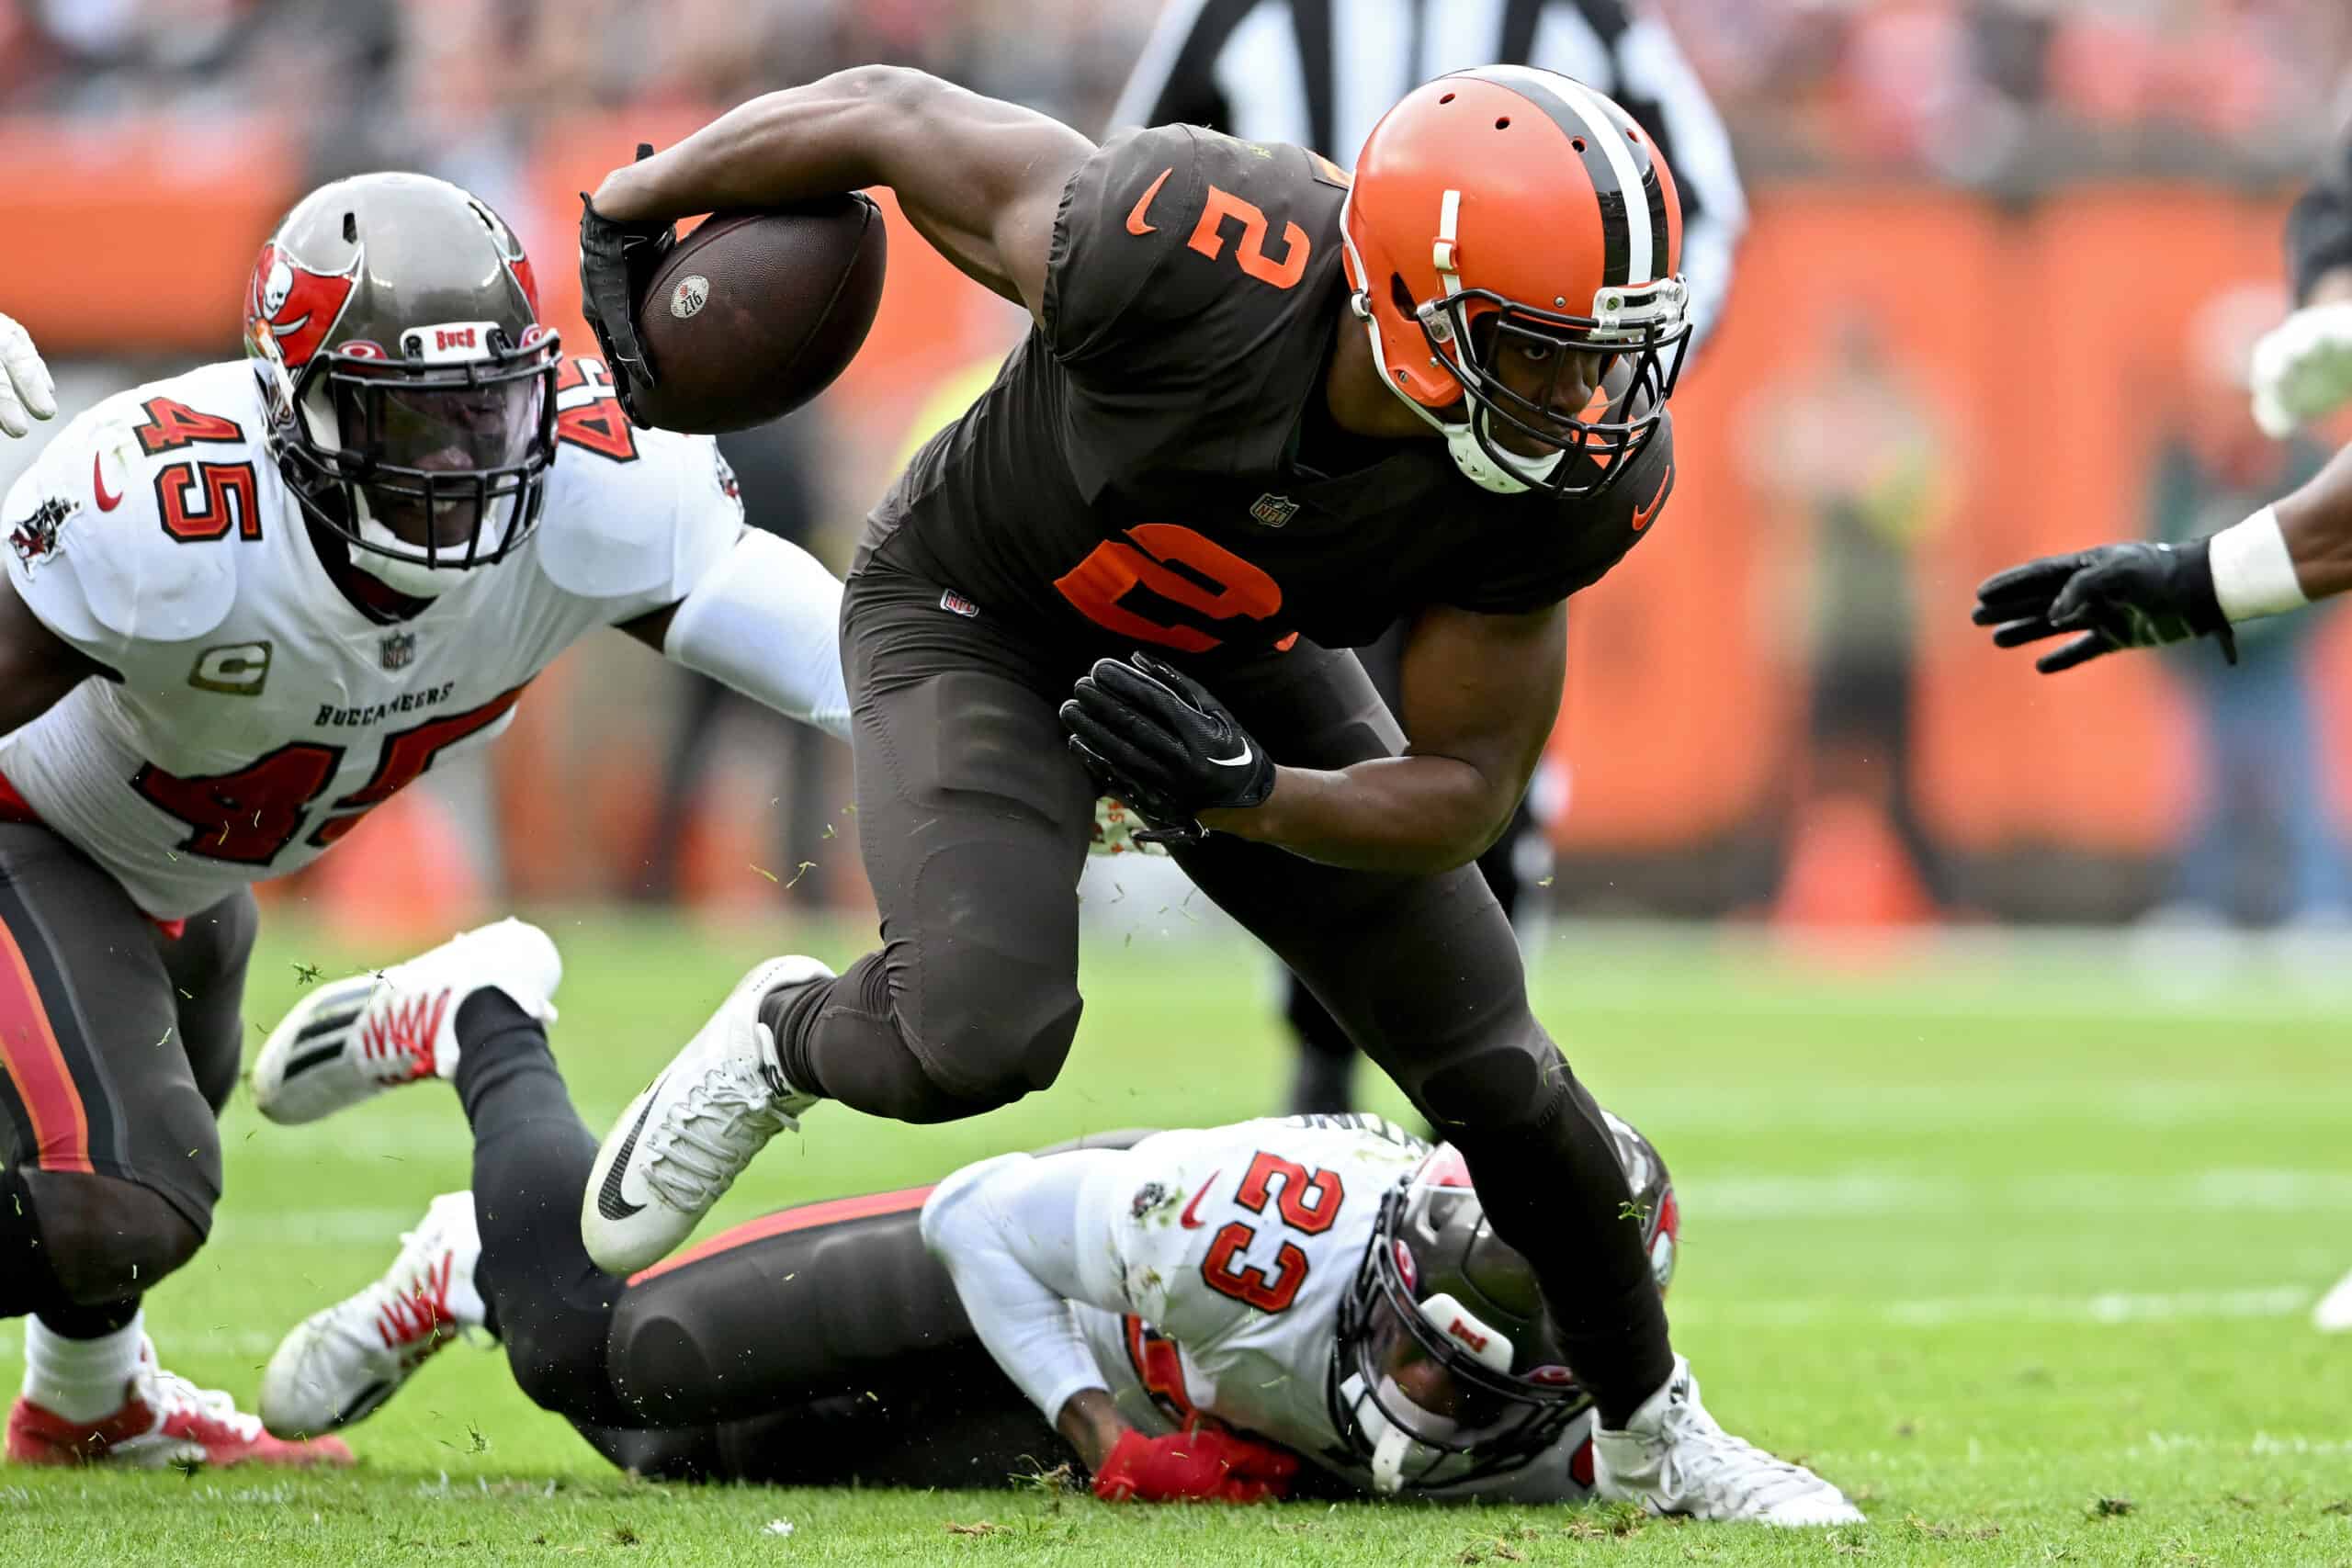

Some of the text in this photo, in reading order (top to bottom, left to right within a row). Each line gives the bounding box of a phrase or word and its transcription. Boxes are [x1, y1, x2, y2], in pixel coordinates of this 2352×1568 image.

[1187, 185, 1311, 289] 2
[680, 290, 704, 315] 276
[131, 397, 264, 543] 45
[199, 645, 266, 683] C
[314, 681, 455, 727] BUCCANEERS
[131, 686, 524, 865] 45
[1201, 1149, 1344, 1314] 23
